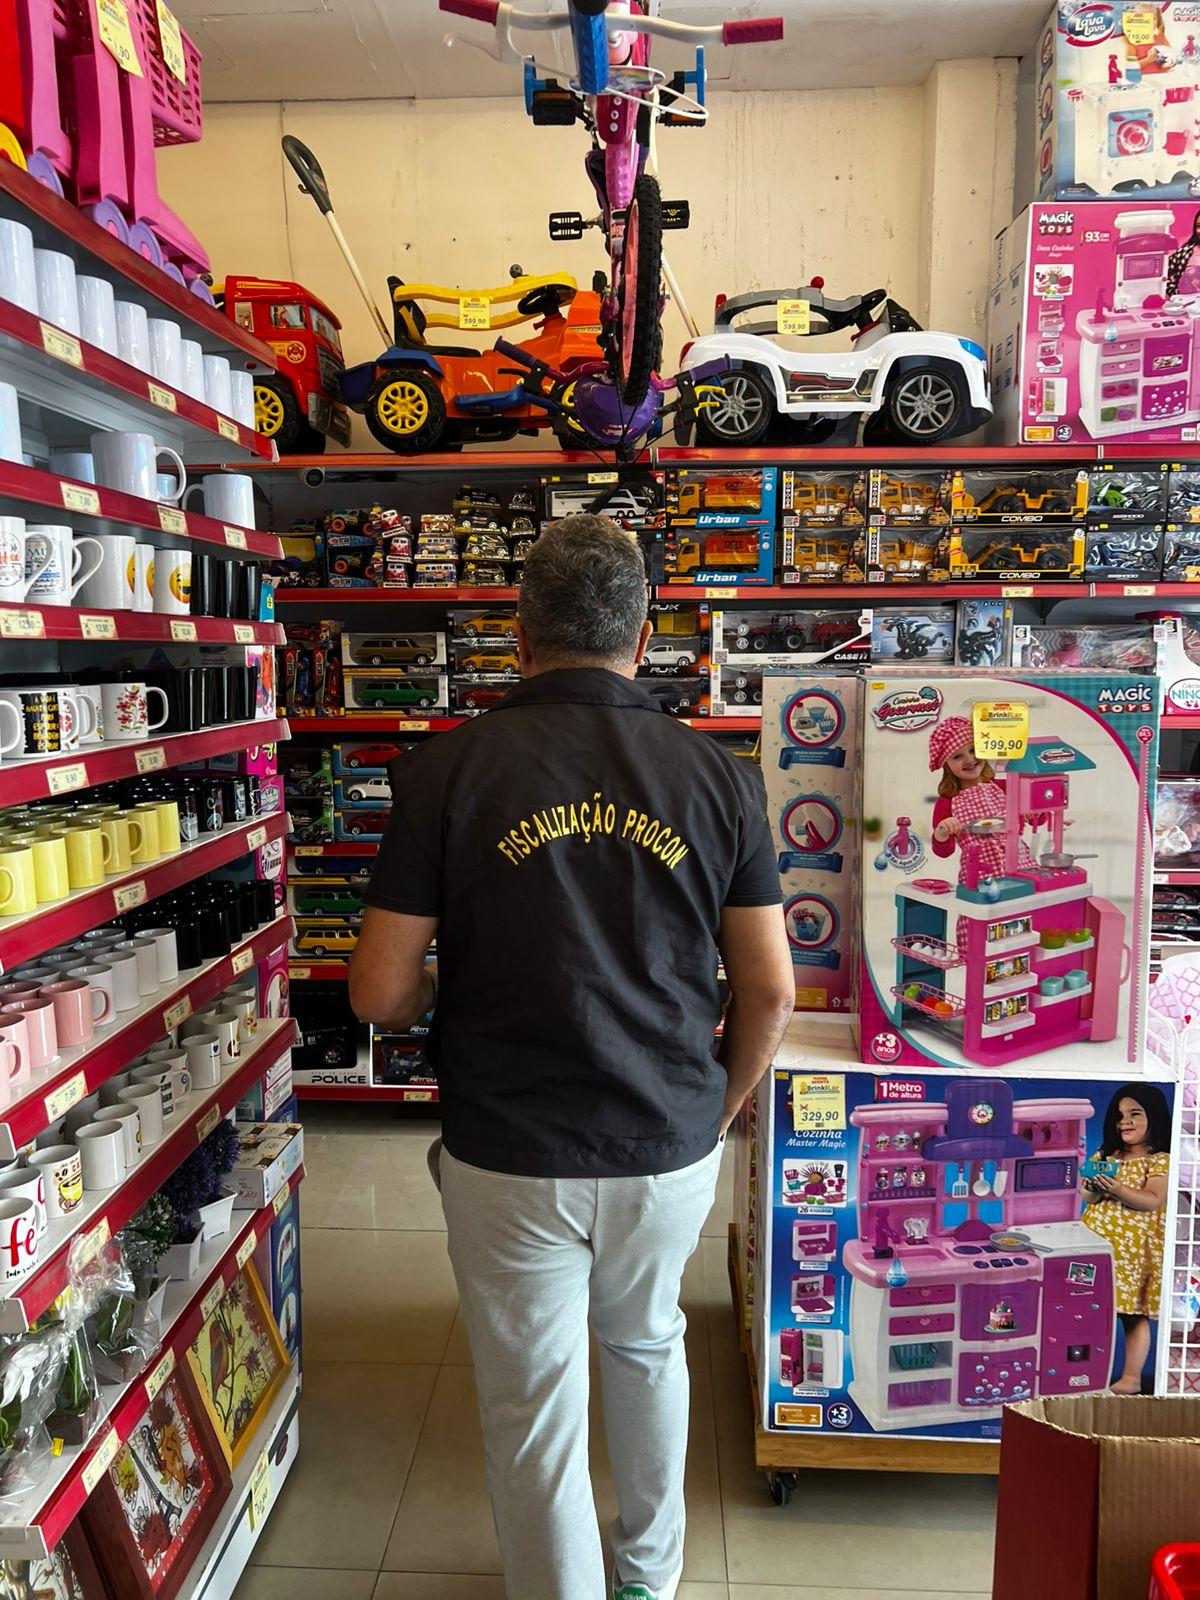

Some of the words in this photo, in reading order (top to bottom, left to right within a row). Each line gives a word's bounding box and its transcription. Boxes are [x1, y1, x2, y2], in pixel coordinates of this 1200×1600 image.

[1085, 231, 1100, 243] 93
[698, 515, 741, 524] Urban
[696, 574, 738, 582] Urban
[999, 572, 1041, 580] COMBO
[834, 653, 859, 661] CASE
[1097, 702, 1151, 713] TOYS
[983, 740, 1023, 751] 199,90
[497, 792, 616, 866] FISCALIZAÇÃO
[622, 809, 690, 870] PROCON
[874, 1033, 896, 1047] +3
[311, 1075, 366, 1084] POLICE
[889, 1083, 922, 1092] Metro
[801, 1111, 839, 1121] 329,90
[786, 1138, 816, 1147] Master
[818, 1138, 846, 1149] Magic
[831, 1407, 848, 1419] +3
